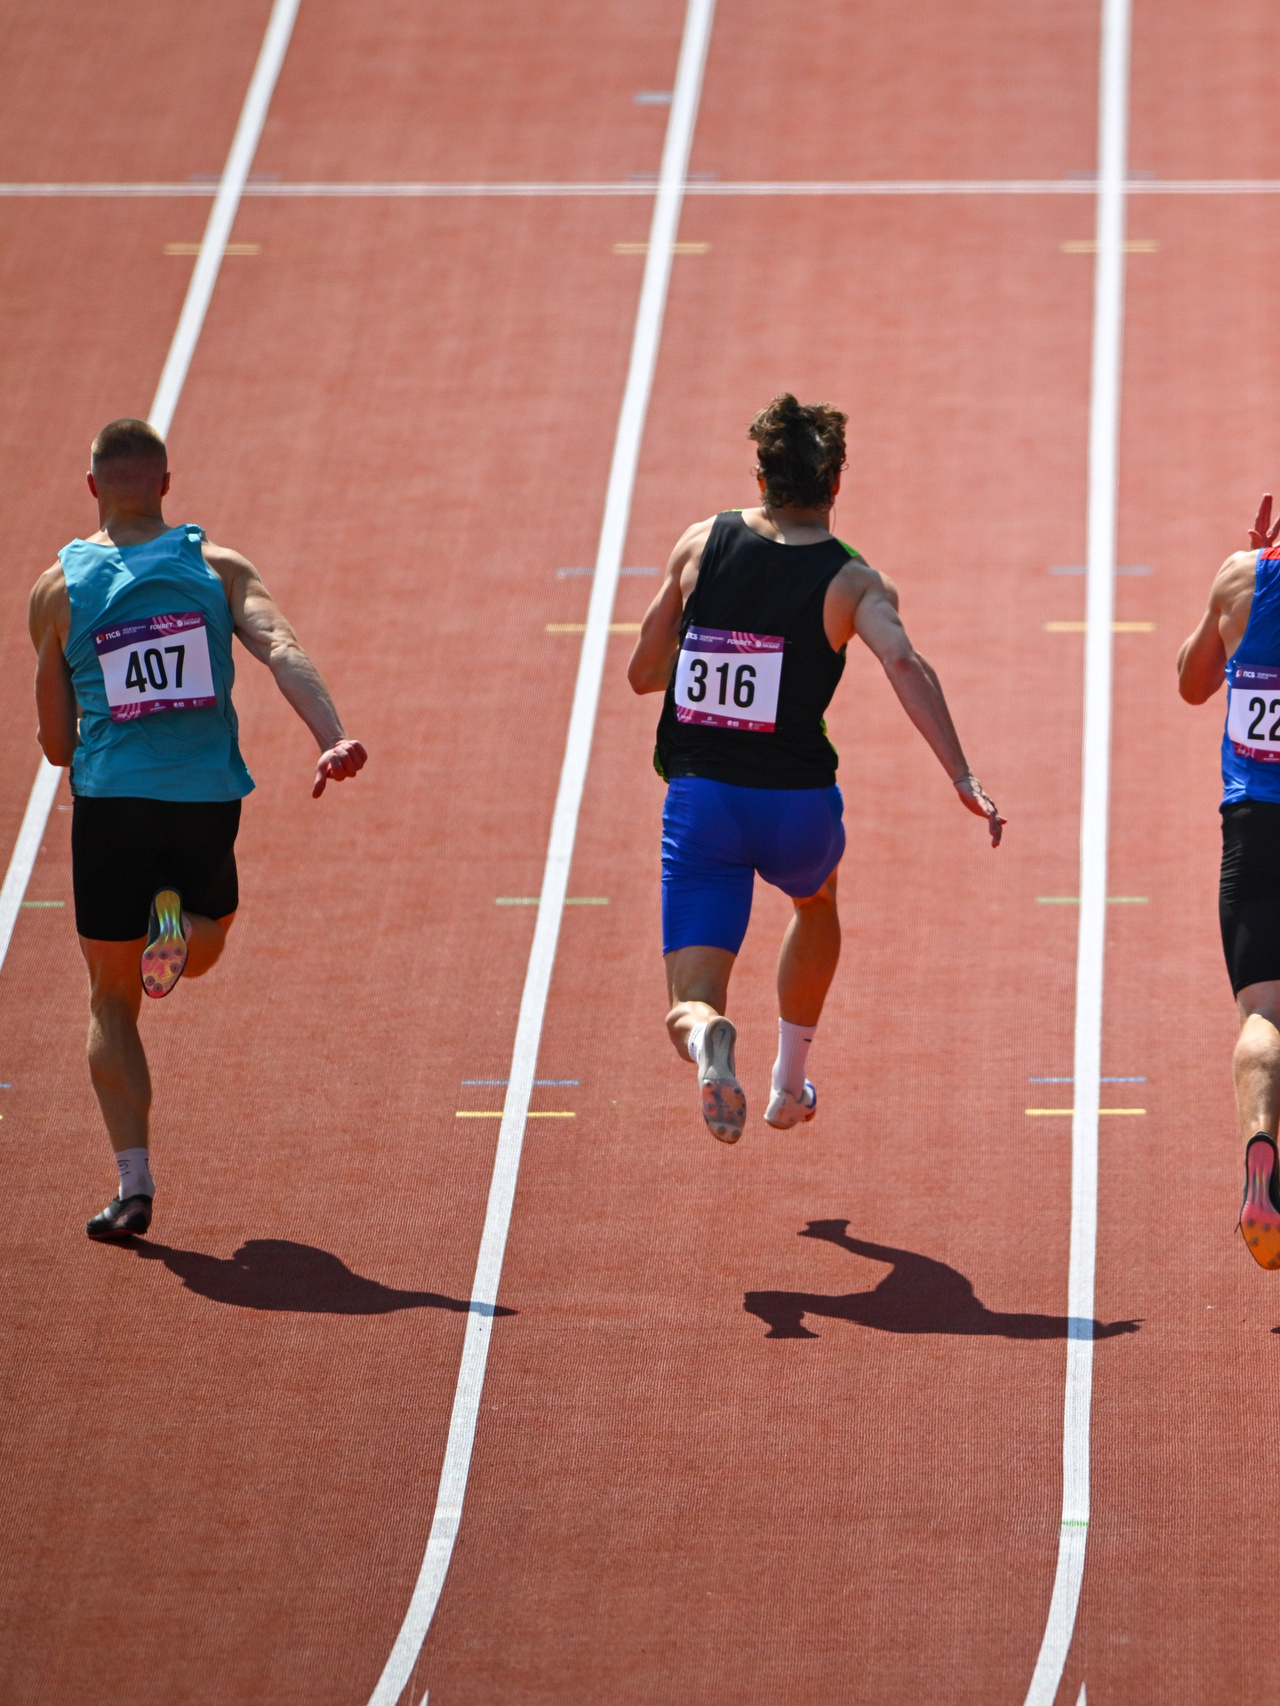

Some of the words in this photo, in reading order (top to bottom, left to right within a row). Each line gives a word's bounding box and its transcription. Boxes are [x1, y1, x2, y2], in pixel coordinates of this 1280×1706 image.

[105, 631, 121, 640] ПСБ
[149, 622, 174, 630] FONBET
[125, 645, 185, 693] 407
[687, 658, 757, 708] 316
